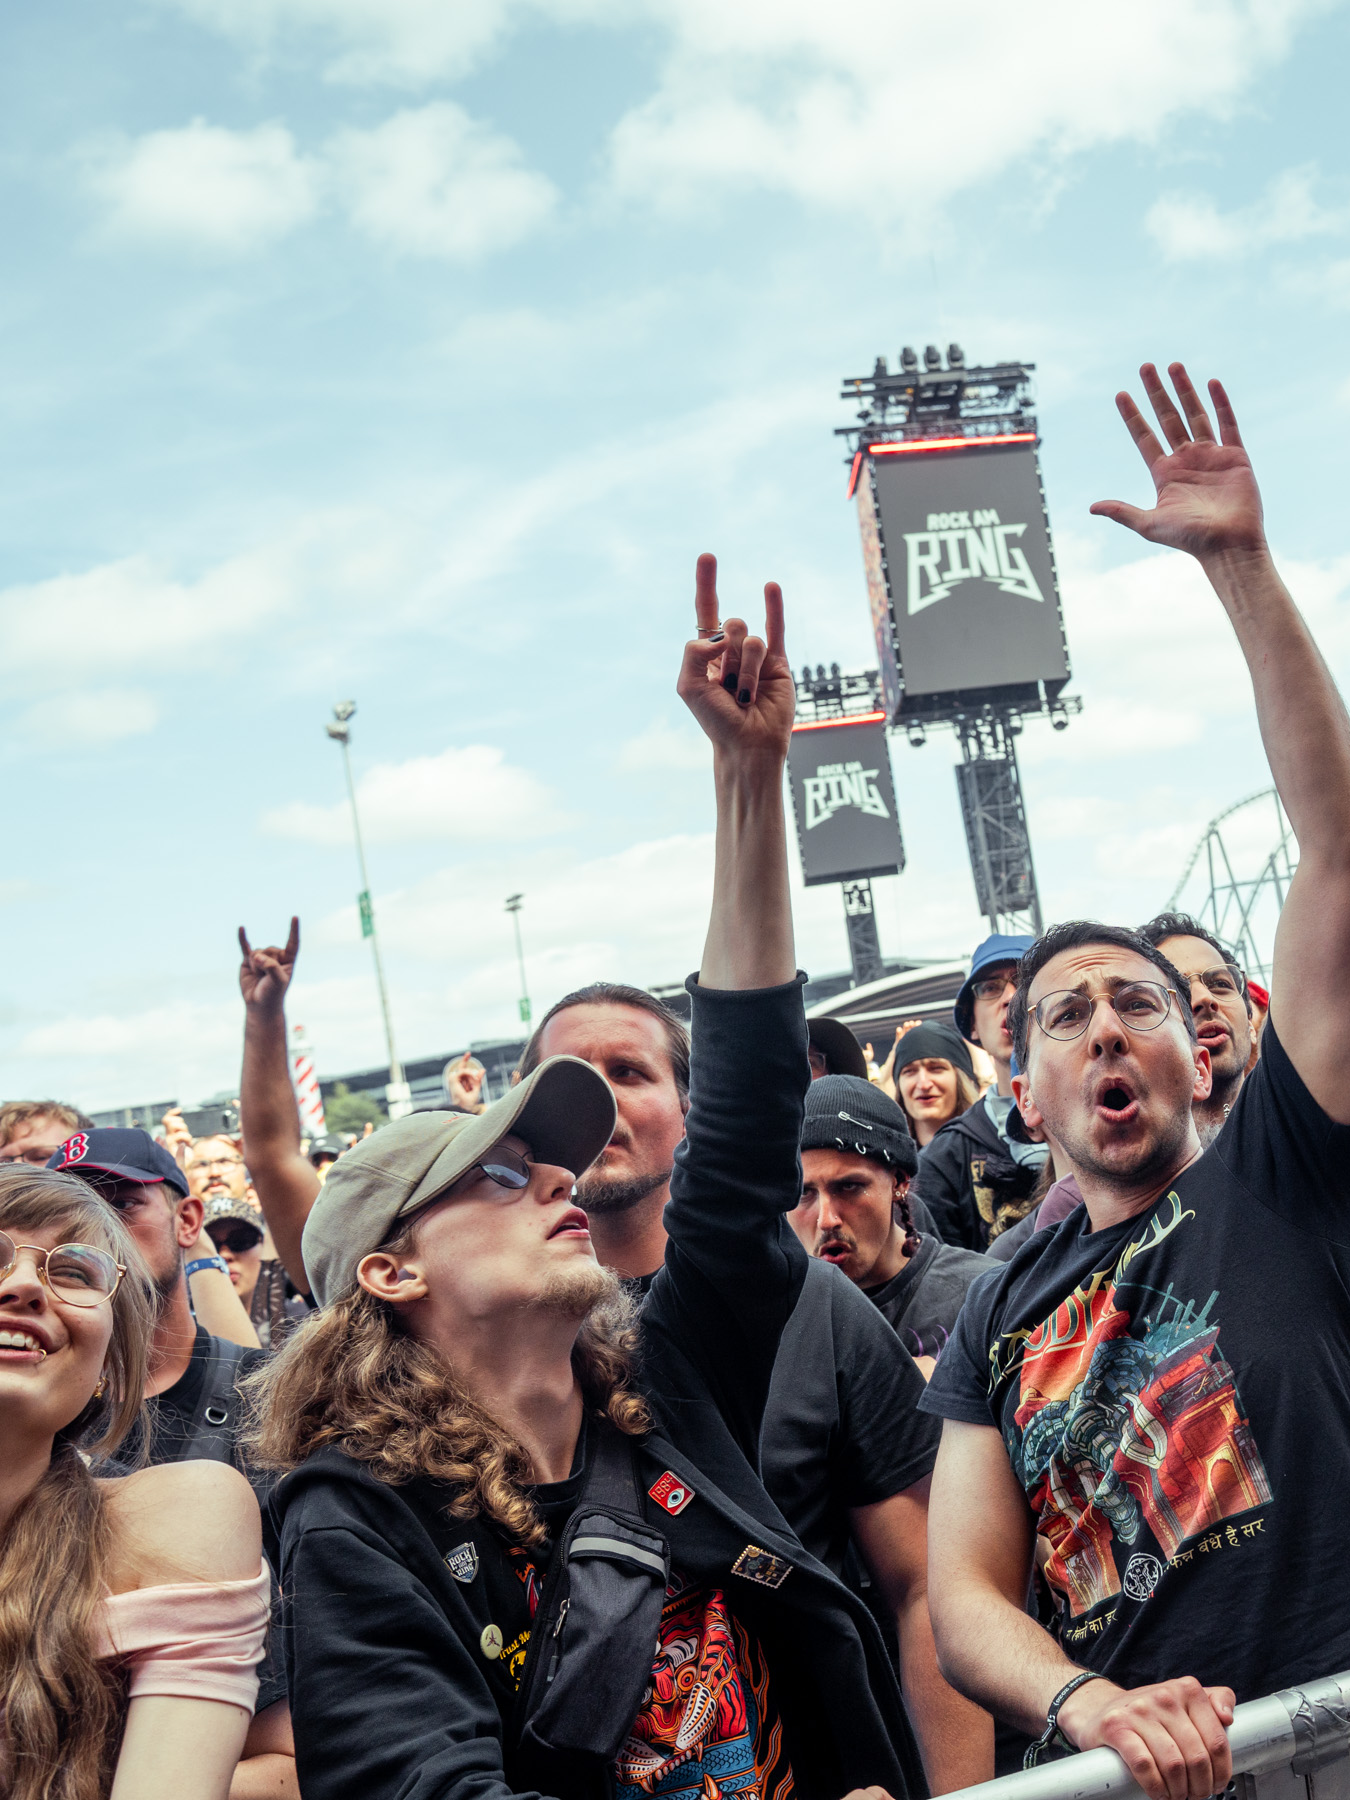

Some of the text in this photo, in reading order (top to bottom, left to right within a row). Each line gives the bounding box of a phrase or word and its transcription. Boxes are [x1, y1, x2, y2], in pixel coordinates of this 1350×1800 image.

[926, 508, 1001, 531] ROCK AM
[902, 522, 1045, 616] RING
[802, 768, 890, 830] RING
[58, 1131, 90, 1168] B
[651, 1475, 676, 1500] 1984
[1225, 1525, 1241, 1547] है
[1240, 1518, 1266, 1538] सर
[448, 1547, 474, 1571] ROCK
[455, 1562, 474, 1577] RING
